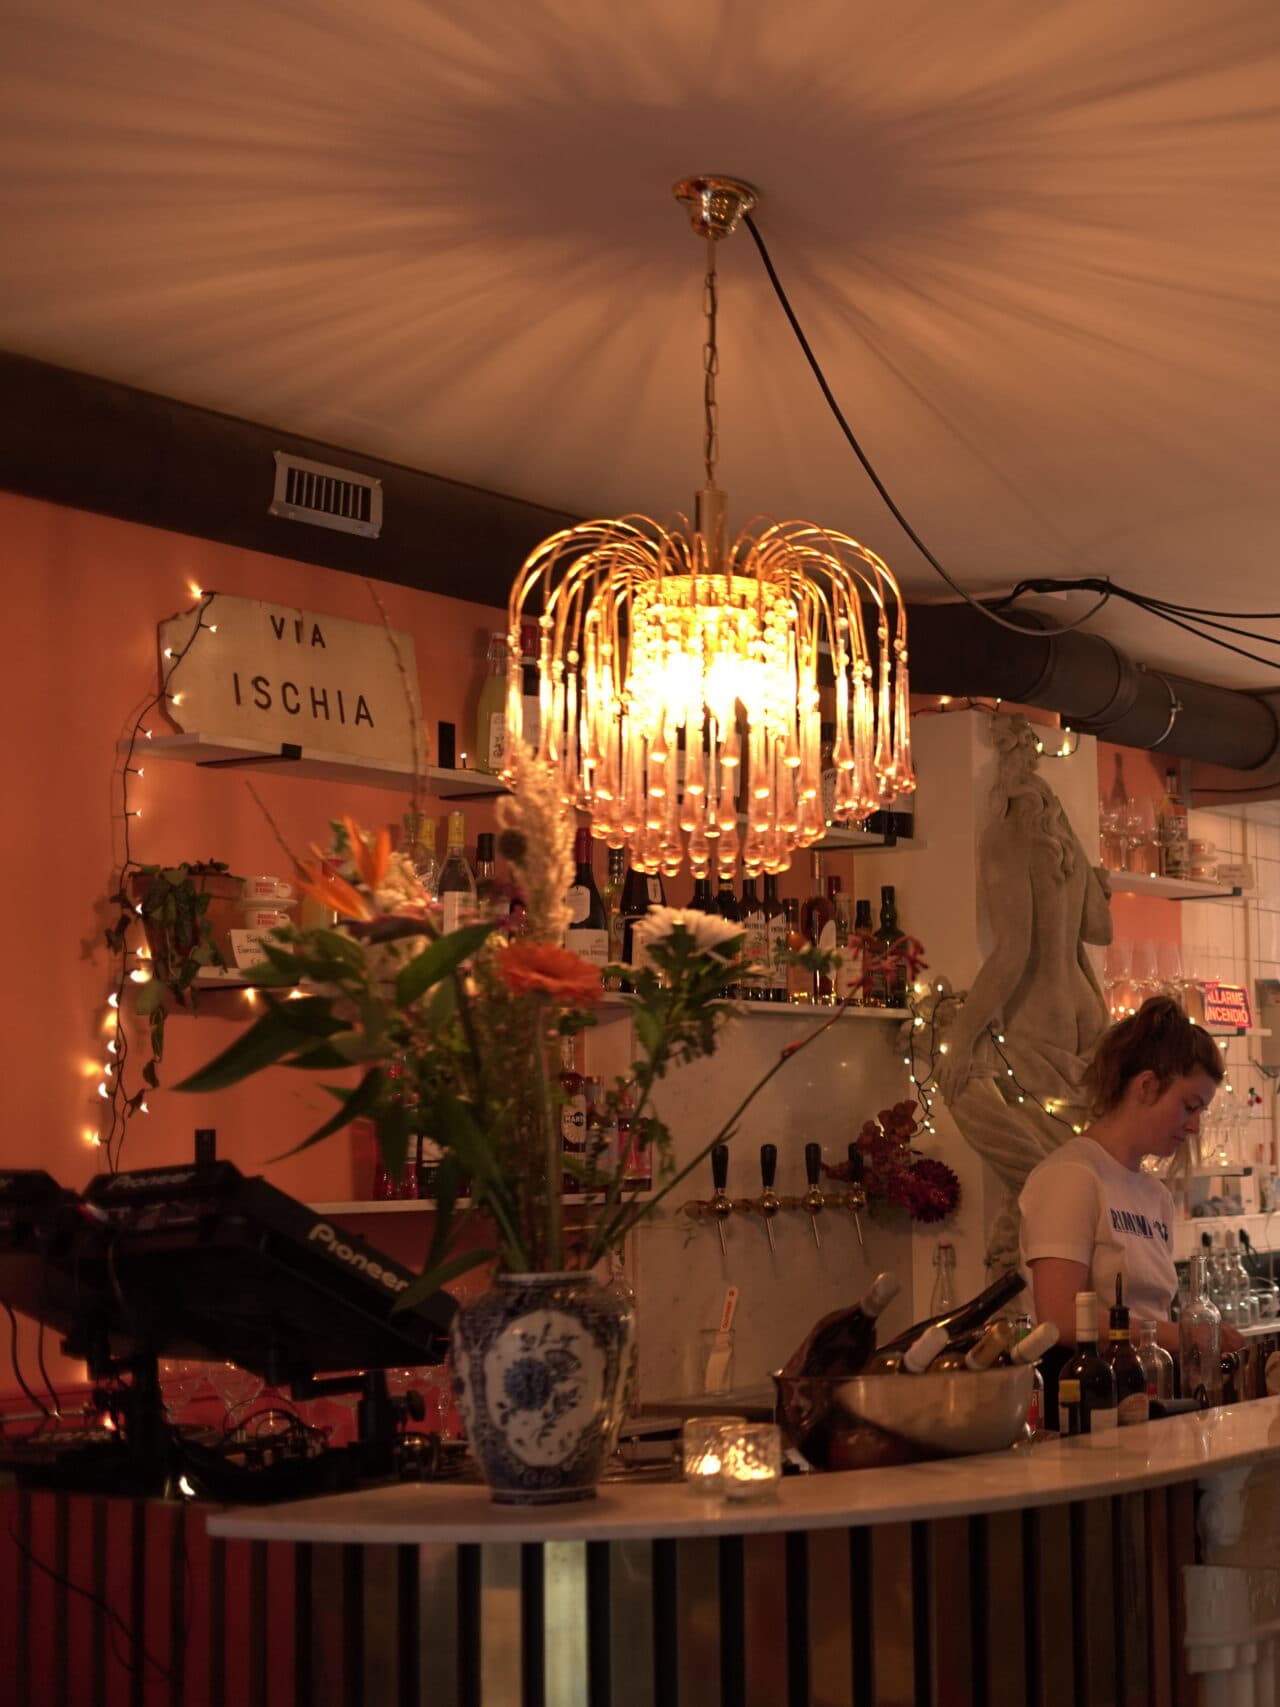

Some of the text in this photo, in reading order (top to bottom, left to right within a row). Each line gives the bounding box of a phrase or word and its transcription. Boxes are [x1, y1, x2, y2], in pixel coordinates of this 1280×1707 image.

[269, 615, 326, 649] VIA
[232, 672, 375, 728] ISCHIA
[1206, 989, 1244, 1005] ALLARME
[1205, 1007, 1248, 1022] INCENDIO
[306, 1223, 411, 1292] Pioneer
